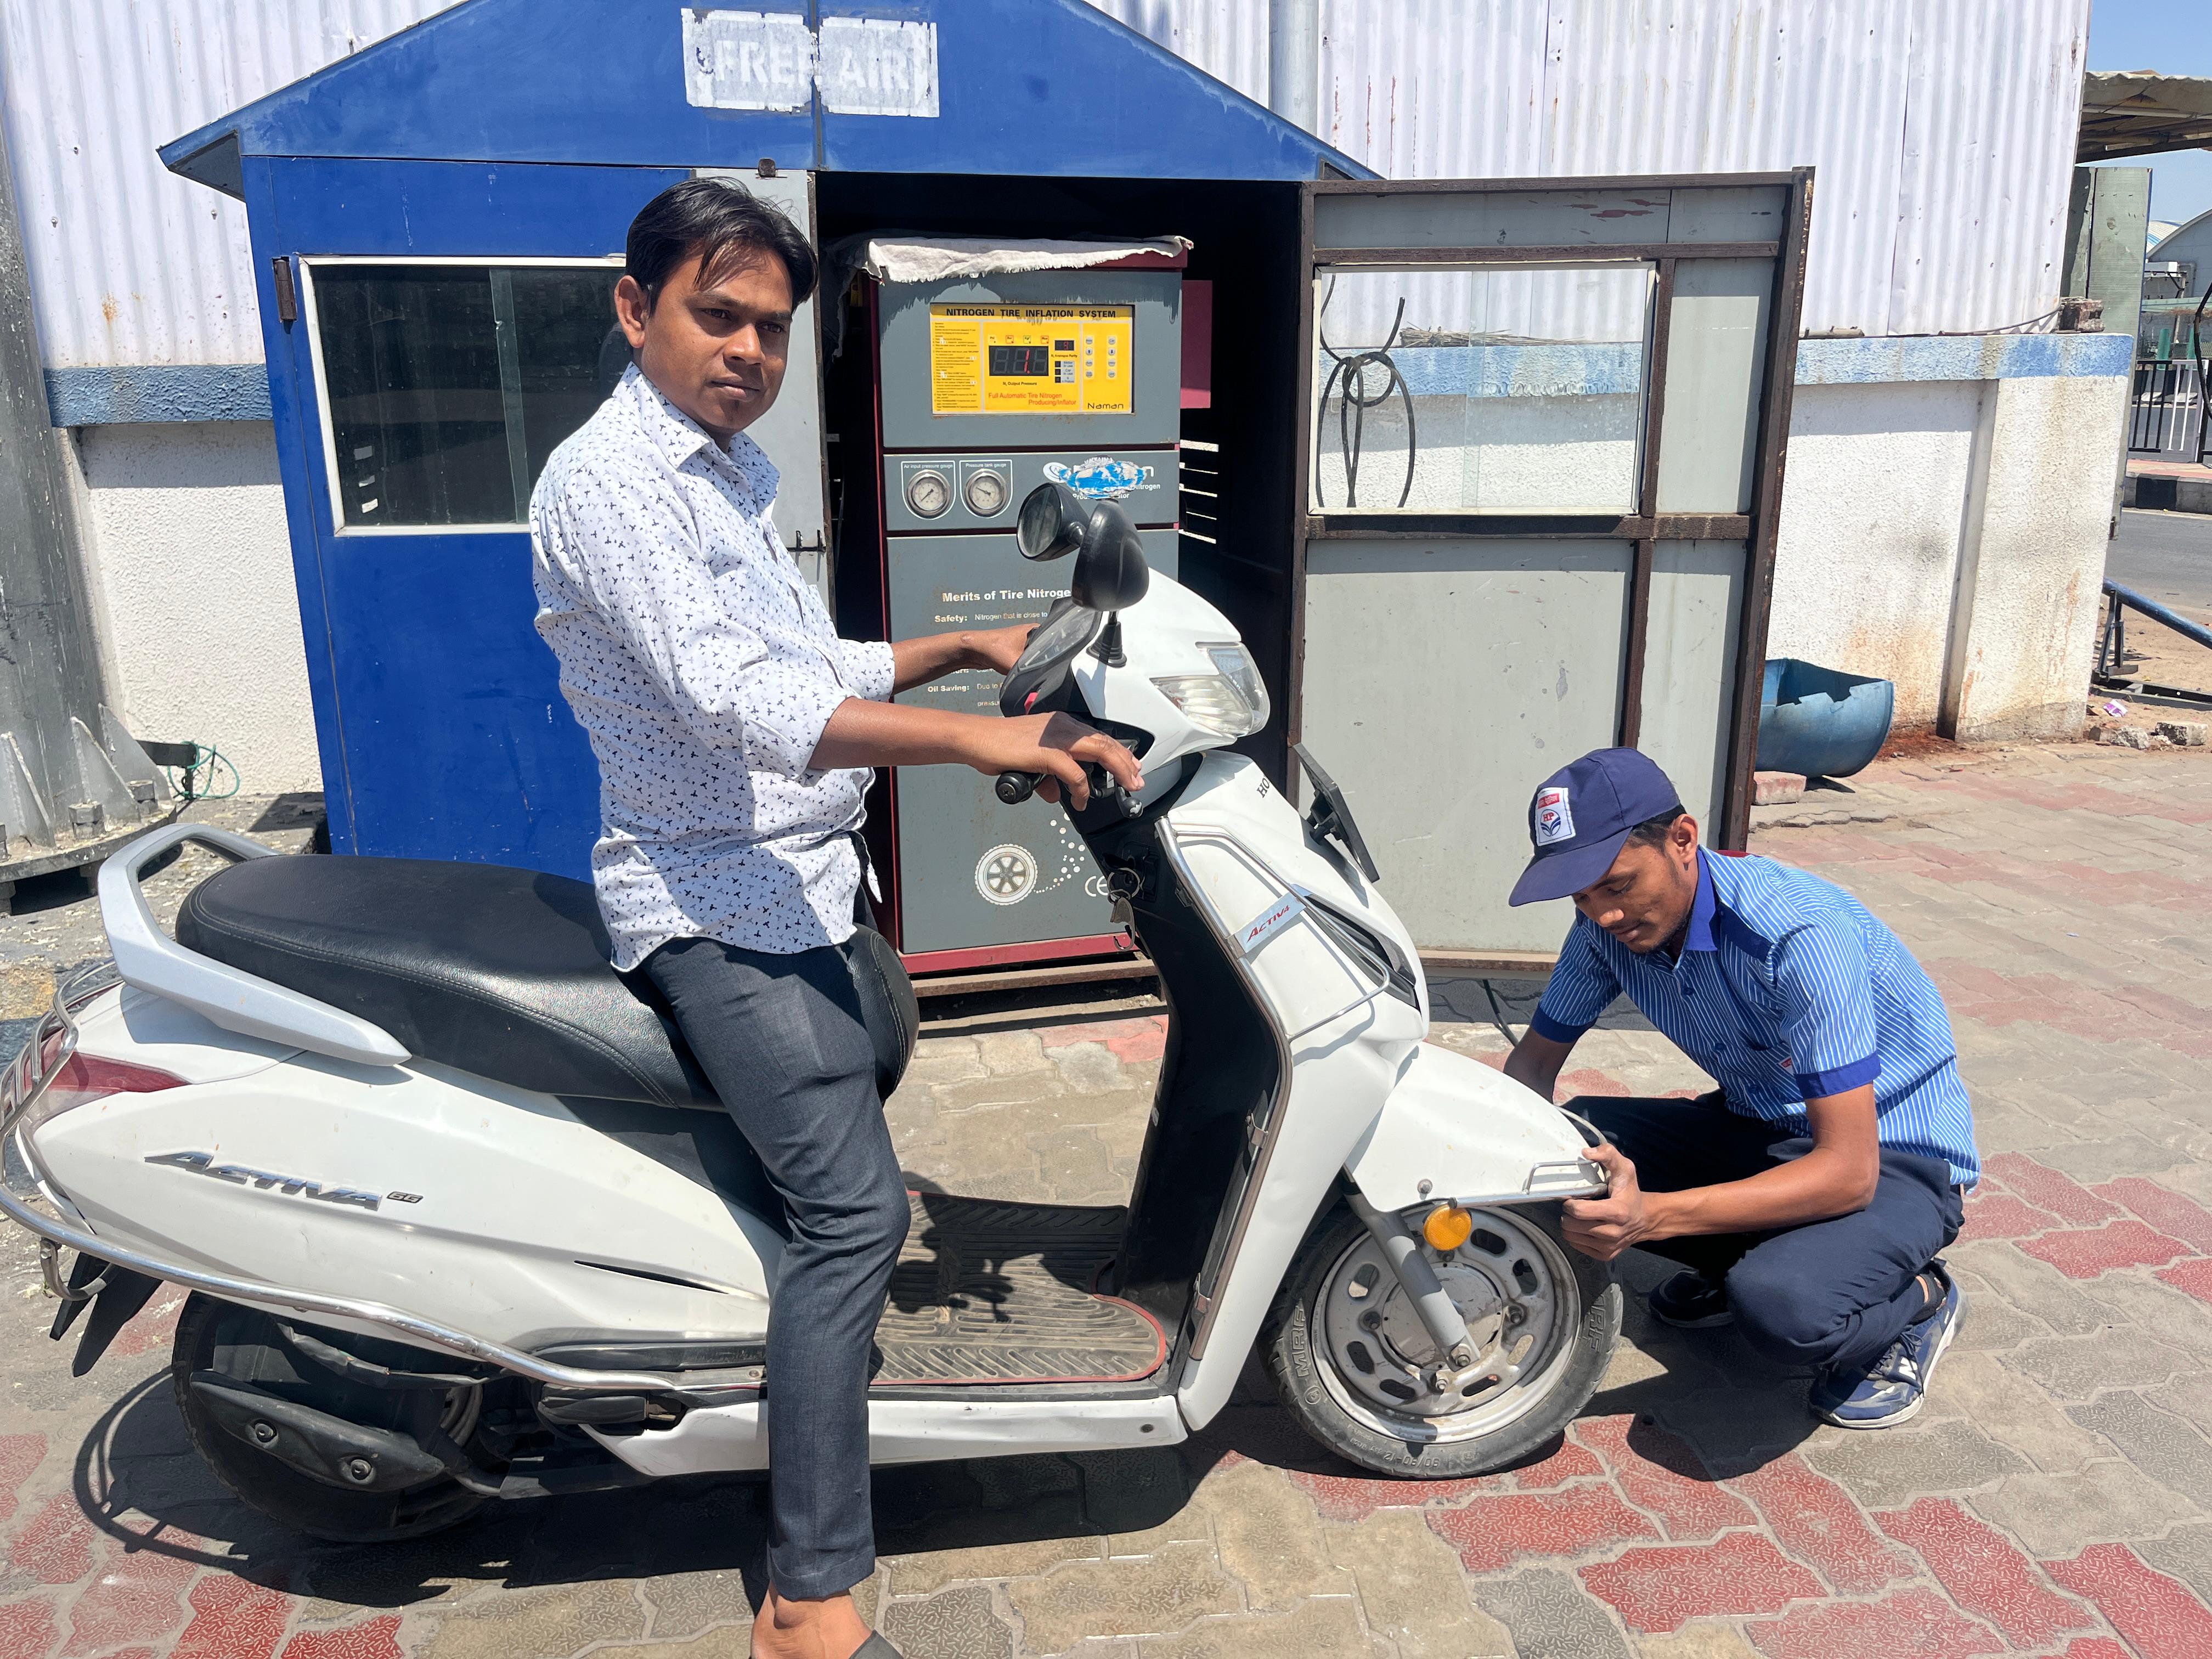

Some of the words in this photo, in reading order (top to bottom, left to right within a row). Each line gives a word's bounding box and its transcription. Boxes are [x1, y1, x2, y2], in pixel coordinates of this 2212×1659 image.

[839, 47, 910, 90] AIR
[946, 308, 995, 317] NITROGEN
[1001, 309, 1020, 317] TIRE
[1026, 309, 1074, 318] INFLATION
[942, 591, 981, 602] Merits
[984, 591, 996, 601] of
[1000, 590, 1024, 600] Tire
[1027, 589, 1072, 600] Nitroge
[934, 614, 968, 623] Safety:
[974, 613, 1002, 621] Nitrogen
[1543, 812, 1554, 822] HP
[1246, 905, 1290, 943] ACTIVA
[144, 1151, 382, 1211] ACTIVA
[388, 1192, 423, 1203] 6G
[1291, 1307, 1310, 1377] MRF
